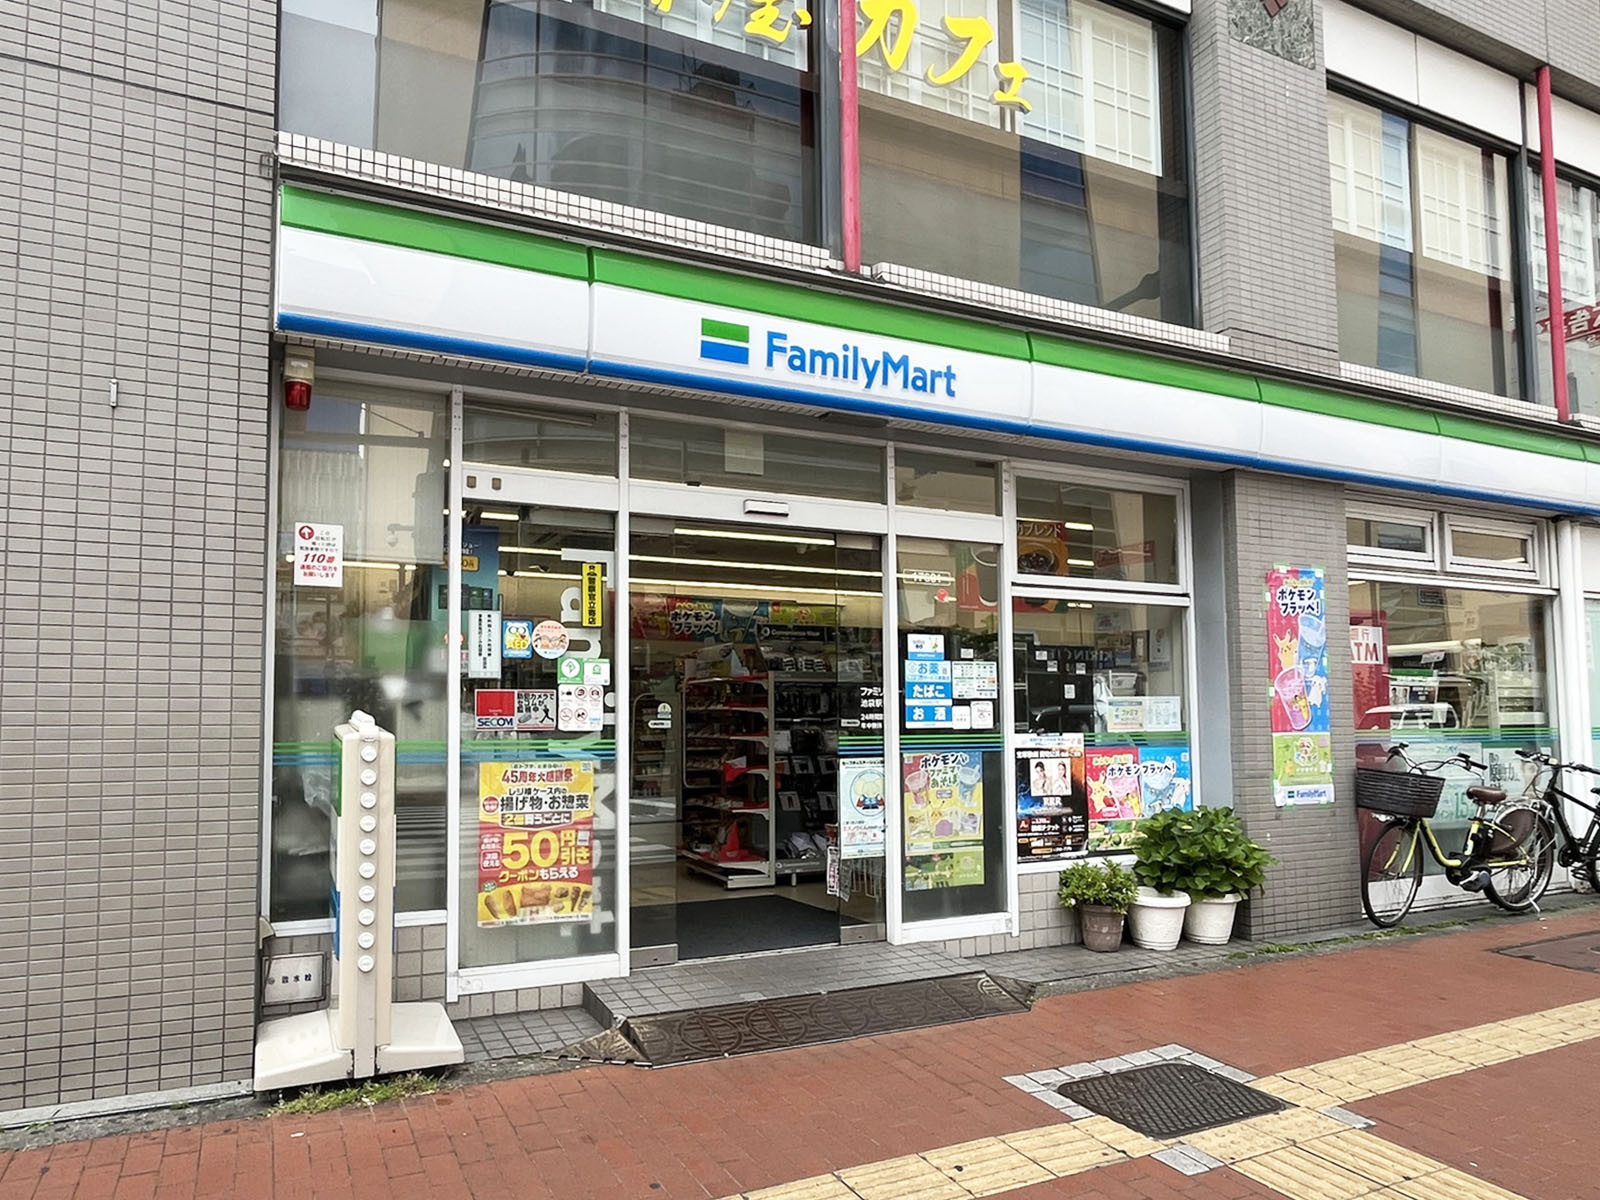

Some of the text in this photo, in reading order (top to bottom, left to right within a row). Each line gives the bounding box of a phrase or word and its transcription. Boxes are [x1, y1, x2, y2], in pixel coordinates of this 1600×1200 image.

[856, 0, 1032, 113] カフェ
[766, 330, 956, 397] FamilyMart
[1277, 588, 1315, 601] ポケモン
[1281, 601, 1320, 615] フラッペ!
[671, 611, 716, 622] ポケモン
[1351, 643, 1379, 661] TM
[912, 684, 946, 698] たばこ
[477, 717, 514, 727] SECOM
[502, 768, 573, 783] 45周年大感謝祭
[508, 786, 568, 796] レジ横ケース内の
[1296, 790, 1327, 799] FamilyMart
[500, 794, 590, 812] 揚げ物・お惣菜
[504, 812, 571, 826] 2個買うごとに
[499, 867, 579, 883] クーポンもらえる
